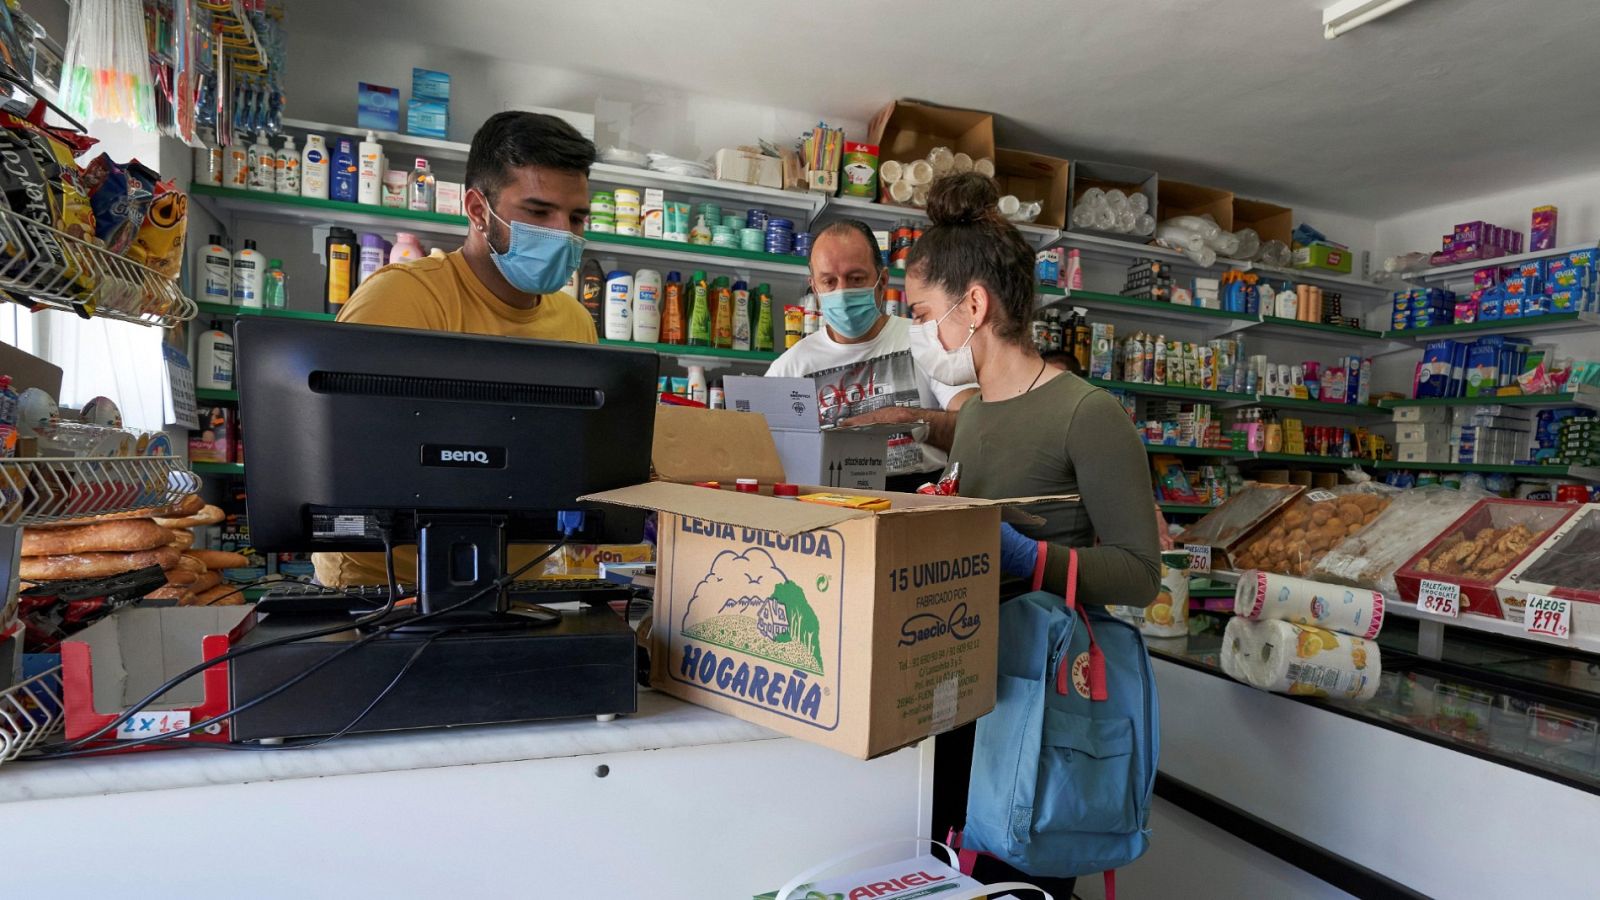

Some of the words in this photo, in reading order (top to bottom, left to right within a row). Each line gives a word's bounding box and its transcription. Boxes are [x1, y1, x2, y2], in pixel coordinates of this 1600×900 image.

[889, 567, 909, 592] 15
[913, 552, 991, 588] UNIDADES
[916, 590, 954, 609] FABRICADO
[953, 587, 968, 601] POR
[1529, 597, 1567, 613] LAZOS
[680, 645, 824, 721] HOGAREÑA
[123, 717, 135, 733] 2
[849, 871, 946, 900] ARIEL
